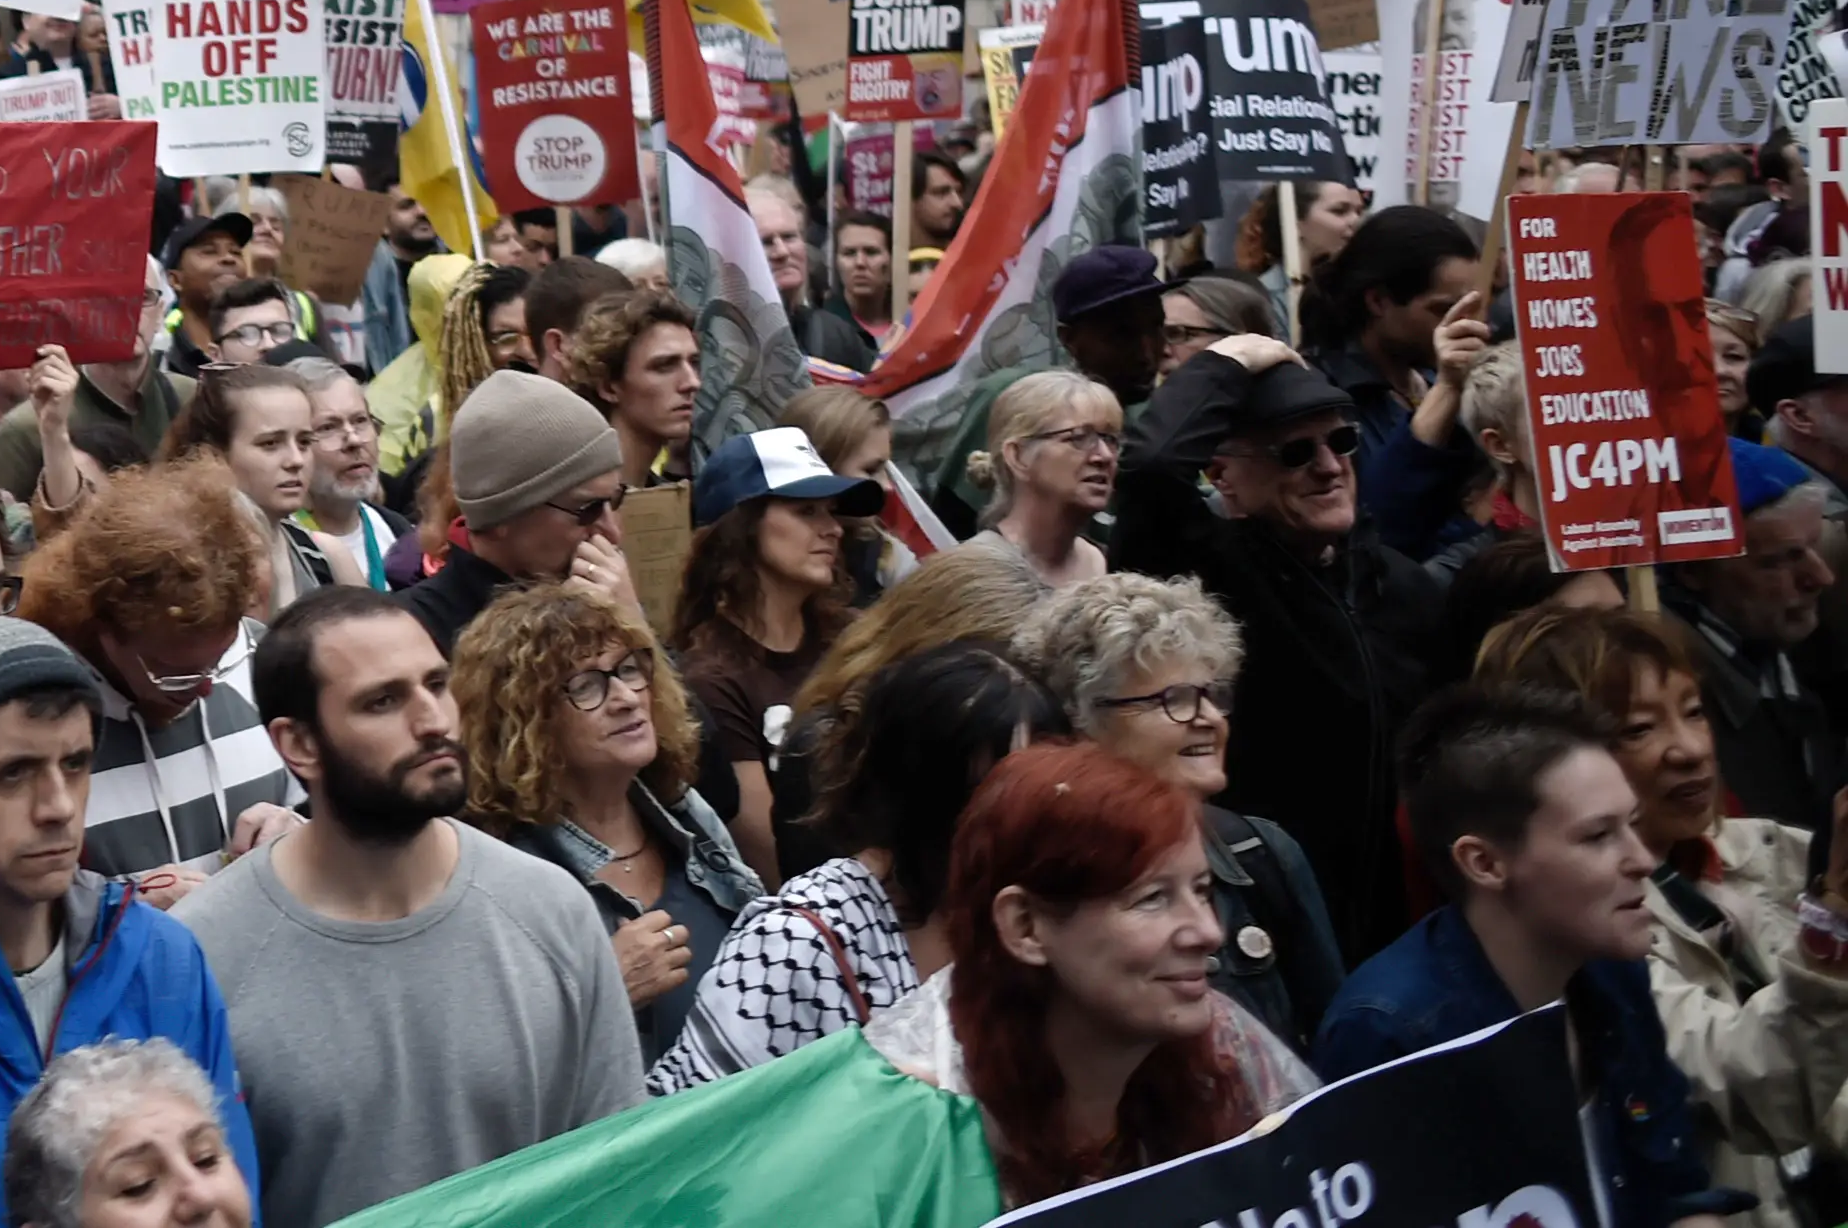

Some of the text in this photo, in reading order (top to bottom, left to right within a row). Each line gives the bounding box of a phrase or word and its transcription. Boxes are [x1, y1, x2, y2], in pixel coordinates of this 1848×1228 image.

[487, 7, 613, 40] WE ARE THE
[851, 4, 963, 55] TRUMP
[202, 38, 279, 78] OFF
[498, 32, 605, 62] CARNIVAL
[536, 57, 568, 79] OF
[850, 59, 894, 83] FIGHT
[1534, 23, 1775, 145] NEWS
[2, 85, 75, 113] TRUMP OUT
[161, 75, 320, 109] PALESTINE
[492, 75, 618, 108] RESISTANCE
[850, 79, 912, 104] BIGOTRY
[532, 136, 585, 154] STOP
[1217, 127, 1335, 156] Just Say No
[41, 146, 131, 201] YOUR
[526, 153, 594, 172] TRUMP
[1148, 183, 1178, 210] Say
[1519, 217, 1557, 240] FOR
[1523, 250, 1593, 282] HEALTH
[1528, 296, 1599, 330] HOMES
[1535, 344, 1585, 378] JOBS
[1540, 388, 1651, 426] EDUCATION
[1548, 436, 1681, 502] JC4PM
